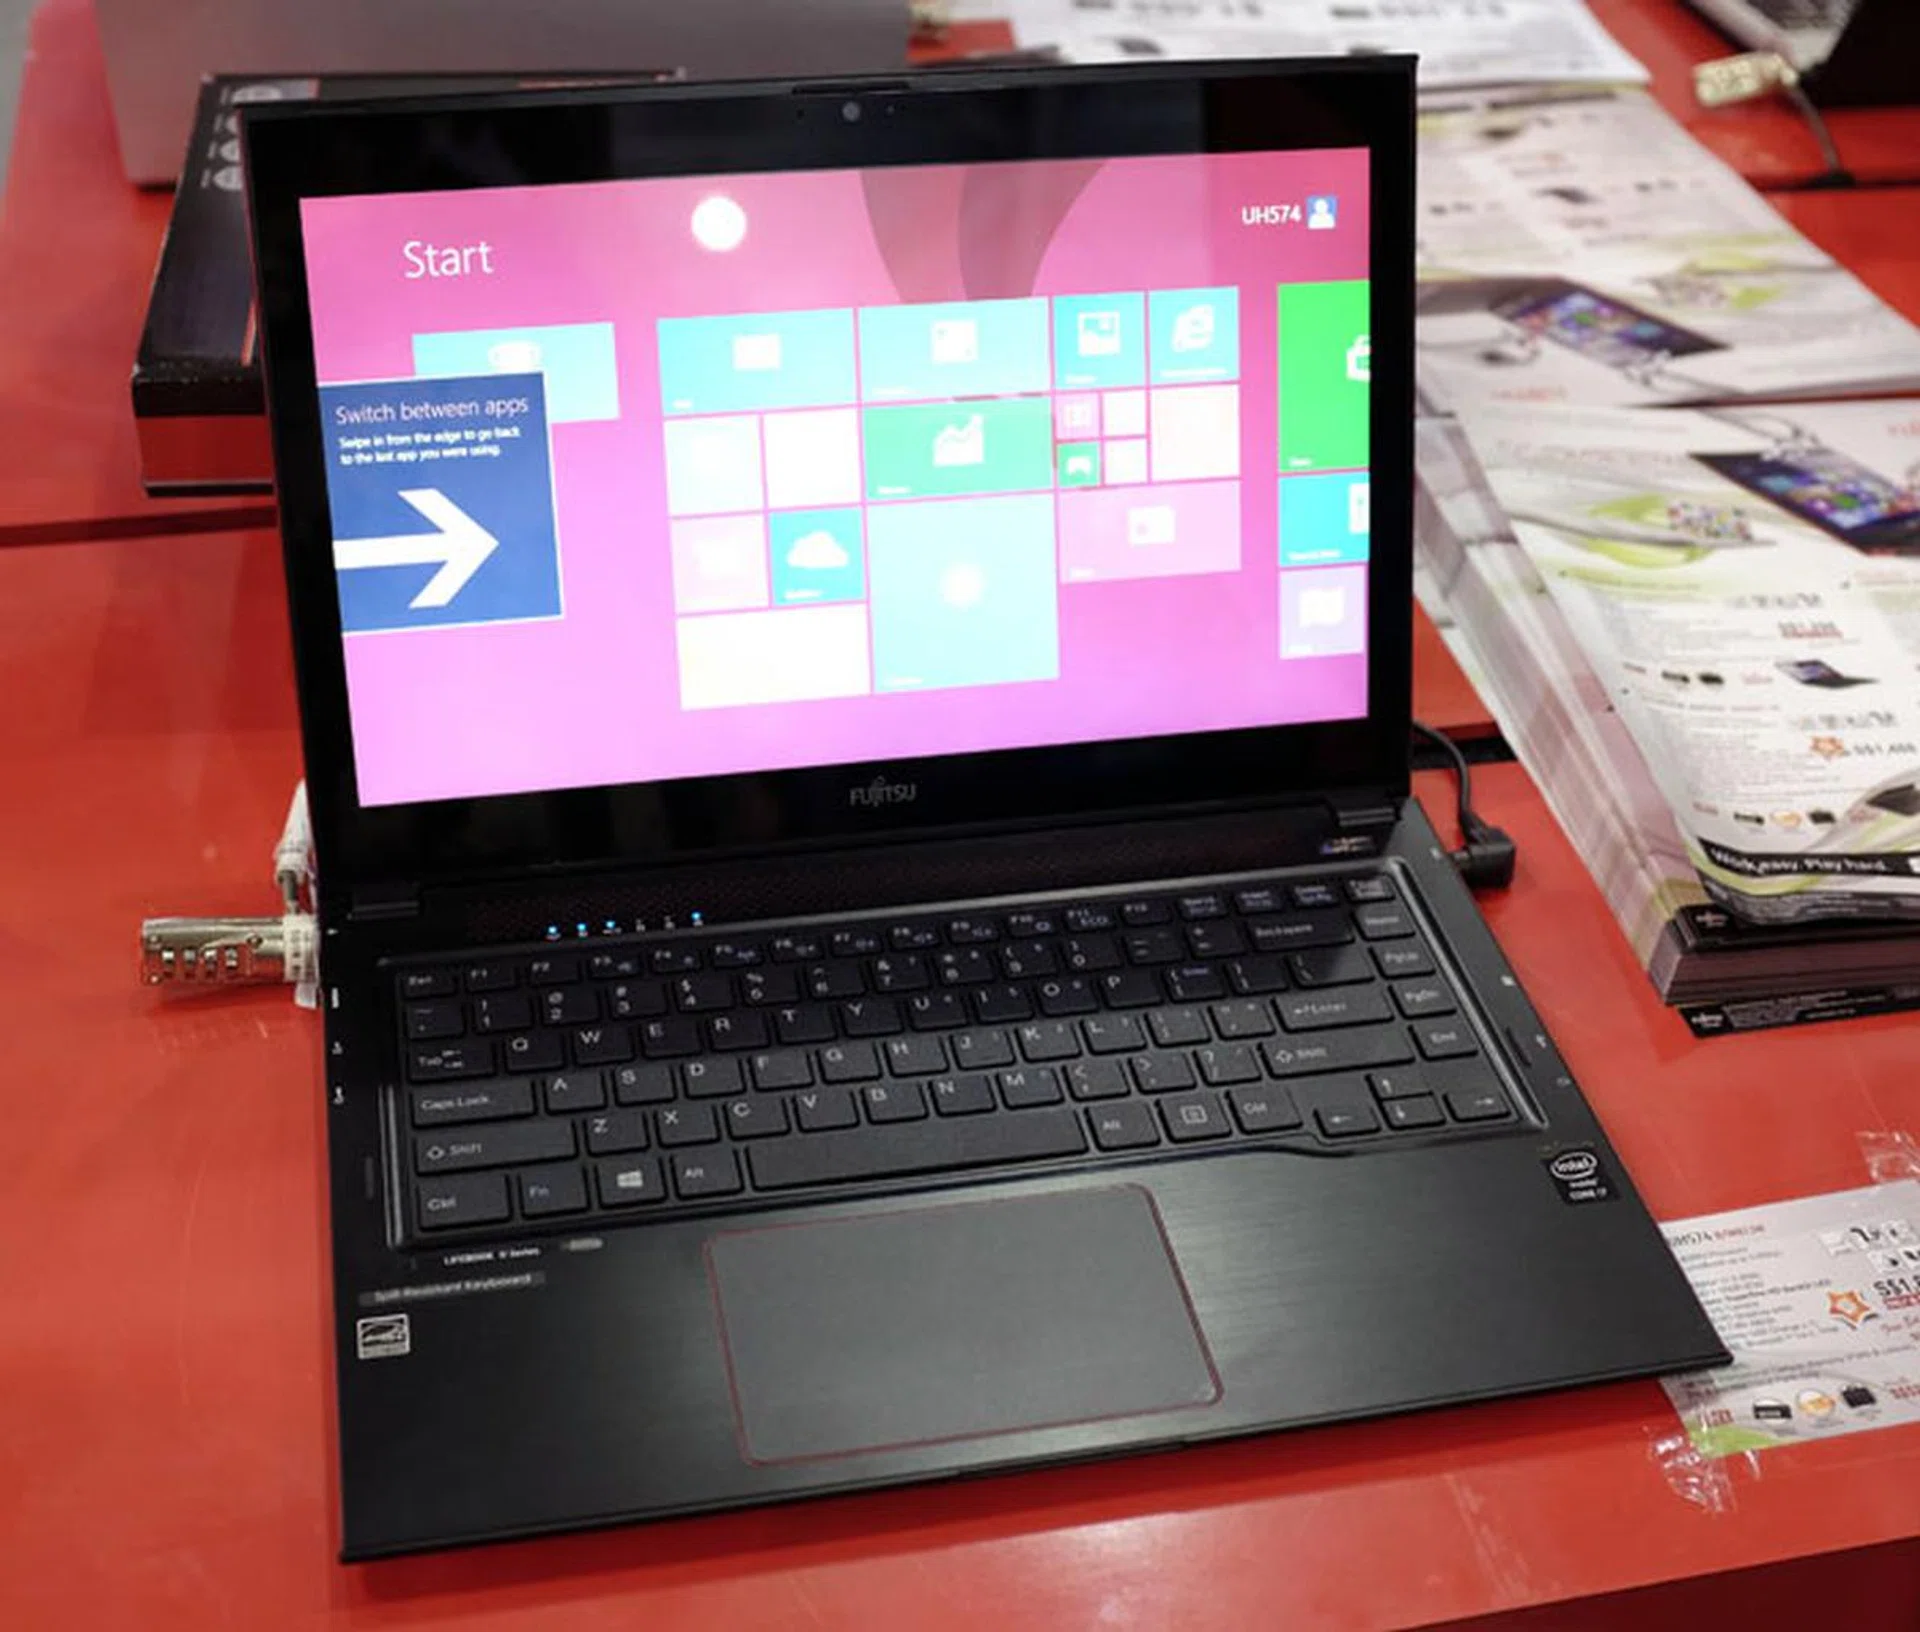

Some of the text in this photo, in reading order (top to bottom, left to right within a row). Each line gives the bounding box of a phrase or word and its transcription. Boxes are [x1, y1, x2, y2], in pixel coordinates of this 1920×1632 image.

[1241, 204, 1302, 225] UH574
[403, 240, 494, 279] Start
[336, 398, 529, 425] Switch between apps
[339, 426, 521, 449] Swipe in from the edge to go back
[340, 454, 352, 465] to
[355, 452, 373, 464] the
[375, 450, 394, 462] last
[397, 450, 418, 463] app
[419, 448, 440, 462] you
[442, 447, 467, 457] were
[849, 774, 916, 808] FUJITSU
[1107, 975, 1121, 988] P
[1043, 983, 1060, 996] O
[848, 1003, 863, 1017] Y
[915, 998, 930, 1010] U
[782, 1009, 796, 1023] T
[650, 1023, 664, 1037] E
[714, 1018, 730, 1031] R
[580, 1031, 600, 1044] W
[1024, 1027, 1041, 1040] K
[892, 1043, 908, 1055] H
[689, 1063, 705, 1076] D
[621, 1070, 636, 1084] S
[1005, 1073, 1025, 1086] M
[553, 1078, 568, 1090] A
[938, 1081, 955, 1094] N
[457, 1095, 489, 1106] Lock
[871, 1088, 887, 1101] B
[803, 1095, 817, 1109] V
[733, 1103, 750, 1117] C
[664, 1110, 679, 1124] X
[594, 1119, 608, 1134] Z
[529, 1186, 549, 1197] Fn
